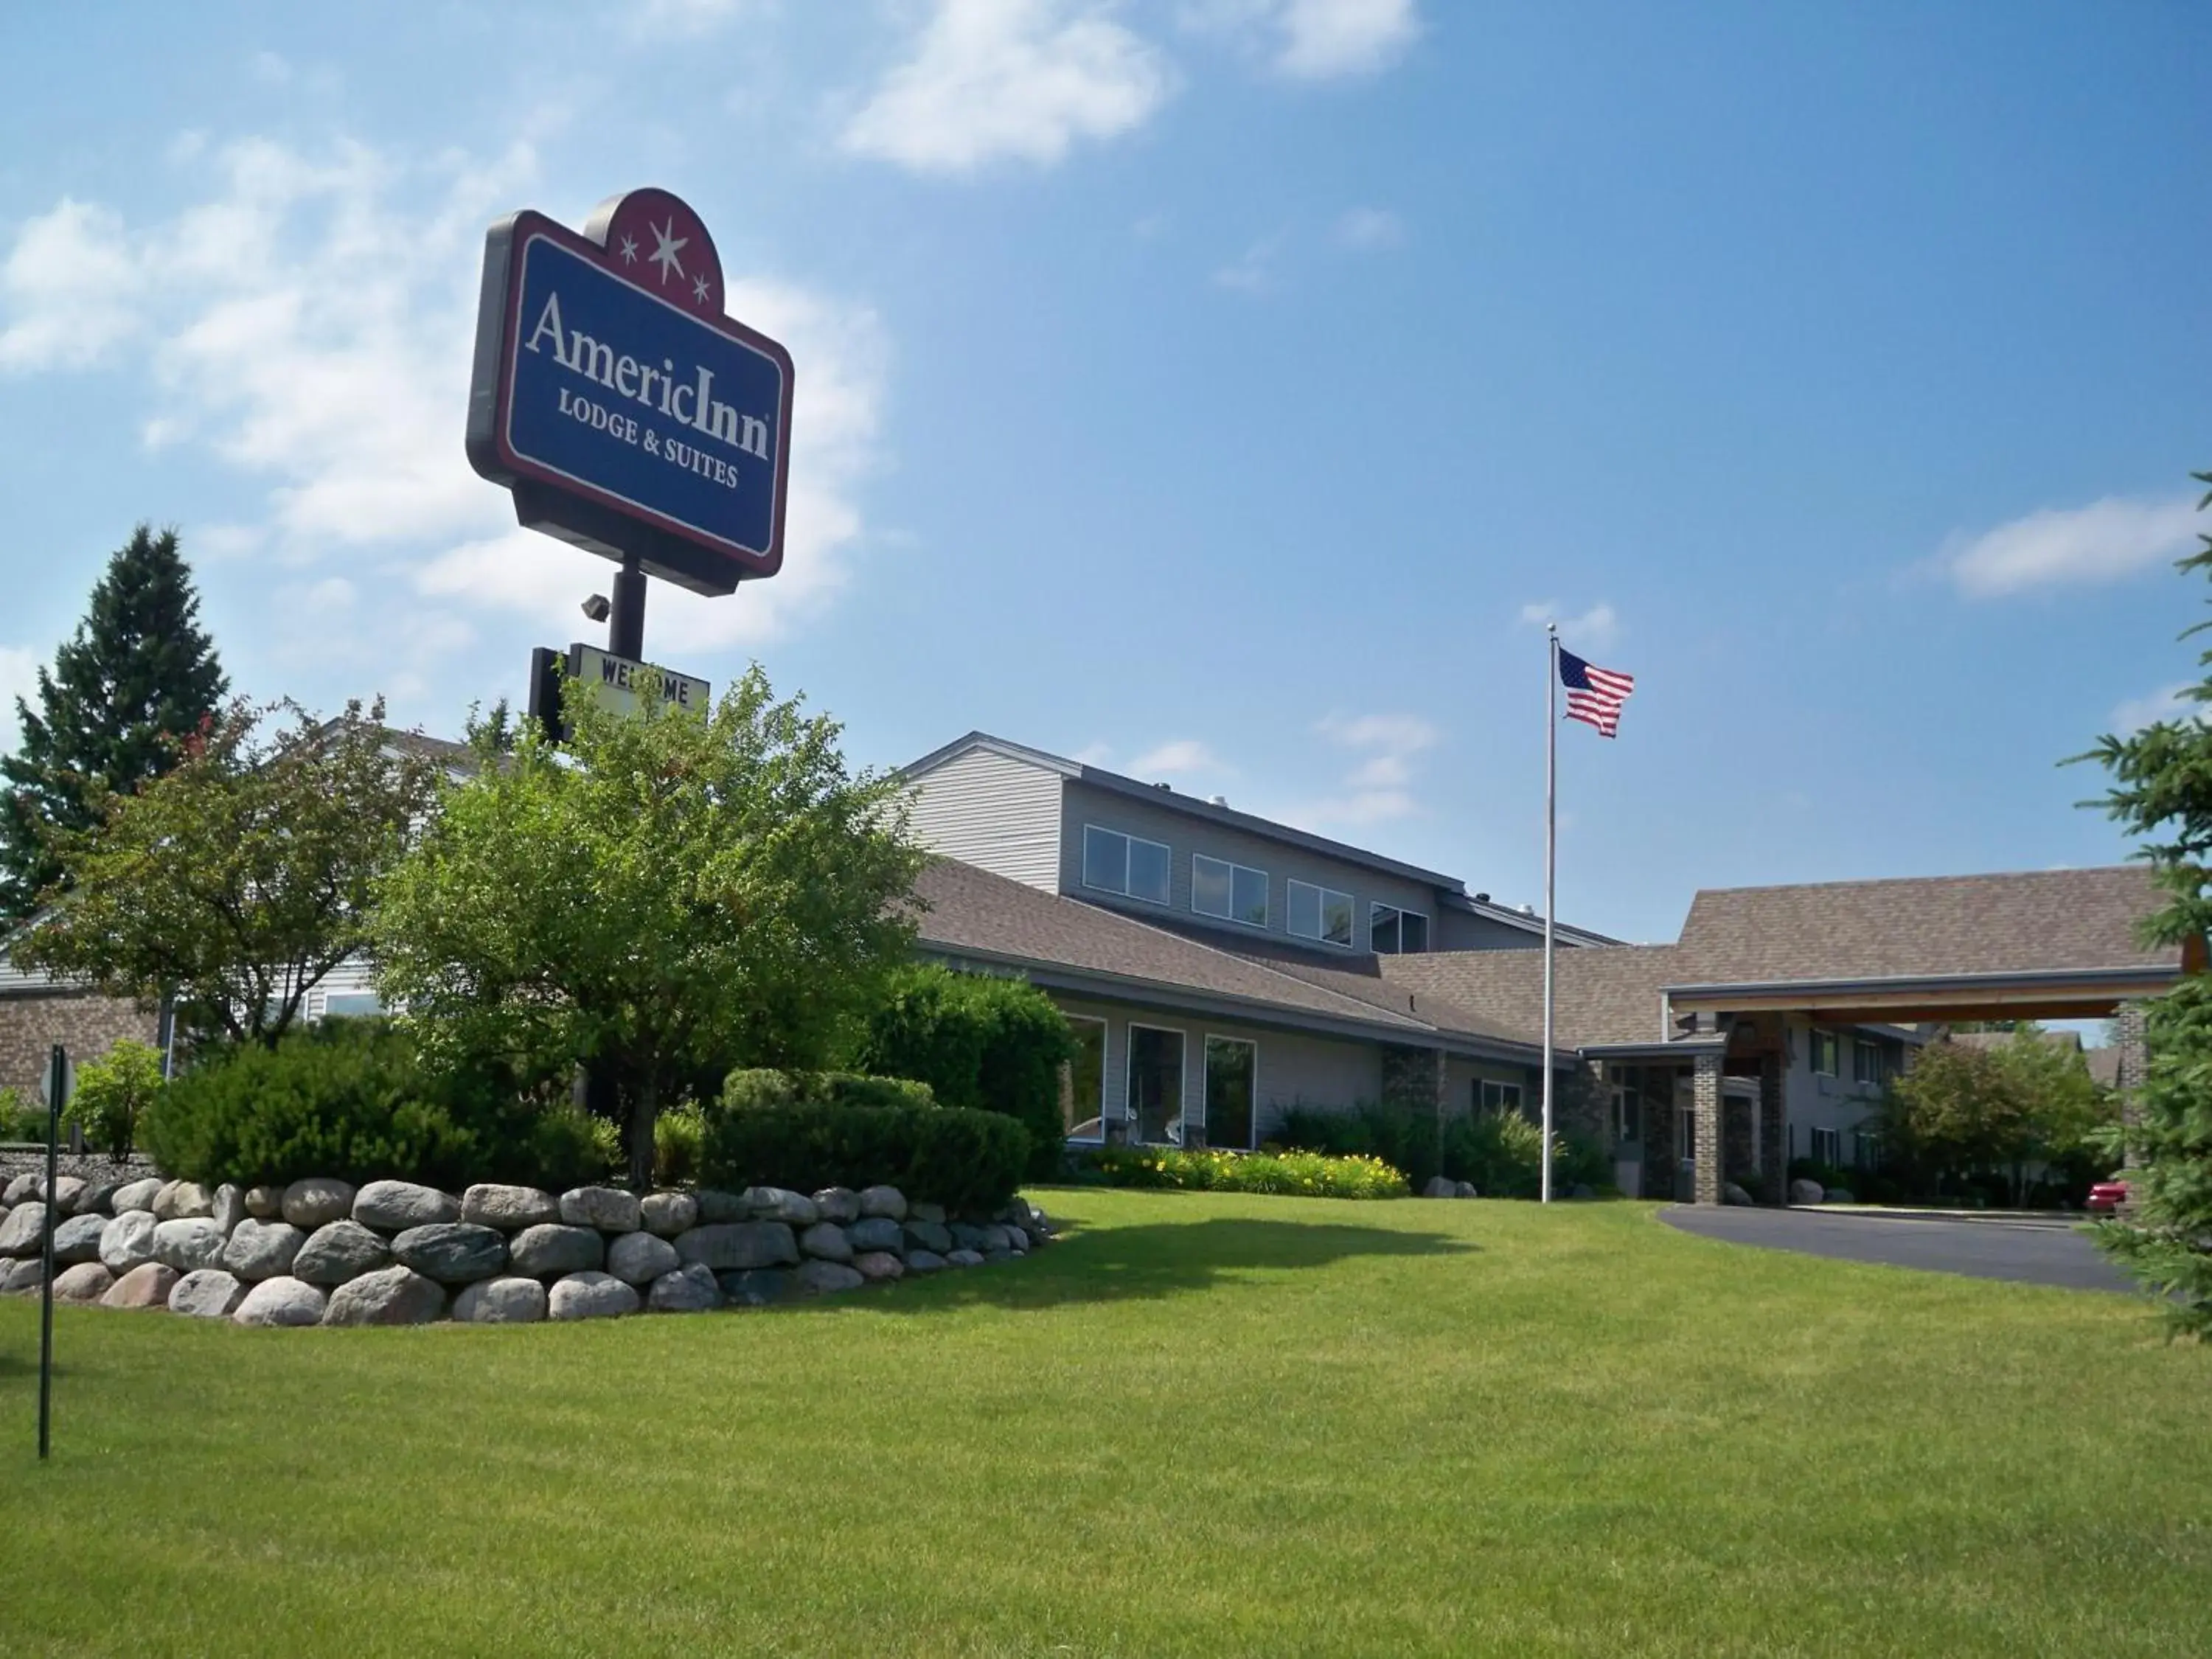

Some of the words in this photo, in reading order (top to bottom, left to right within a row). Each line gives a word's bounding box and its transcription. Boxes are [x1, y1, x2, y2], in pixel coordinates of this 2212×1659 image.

[525, 291, 769, 461] AmericInn
[558, 387, 639, 446] LODGE
[644, 429, 661, 456] &
[664, 438, 738, 489] SUITES
[602, 658, 689, 704] WELME
